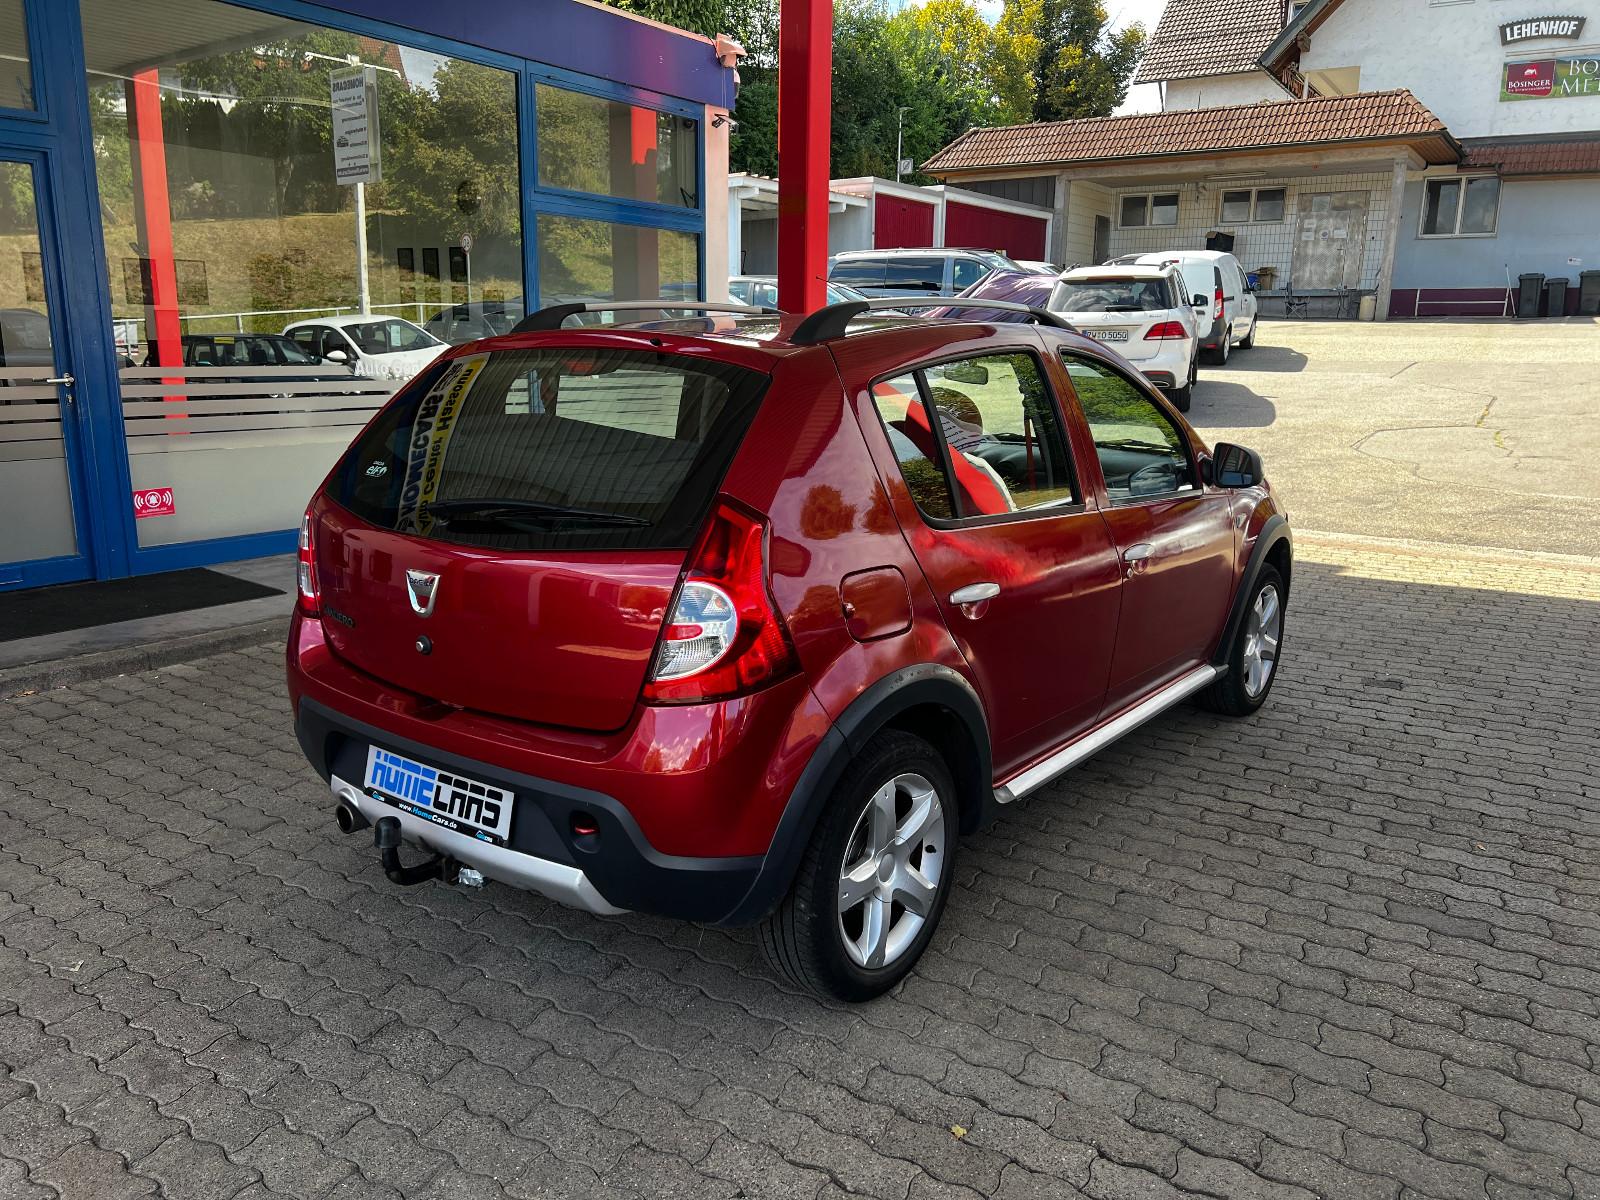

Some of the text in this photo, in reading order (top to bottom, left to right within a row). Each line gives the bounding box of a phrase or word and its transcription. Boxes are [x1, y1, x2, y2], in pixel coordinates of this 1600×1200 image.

[1505, 20, 1578, 41] LEHENHOF
[370, 750, 504, 829] HOMECARS
[398, 802, 458, 829] www.HomeCars.de
